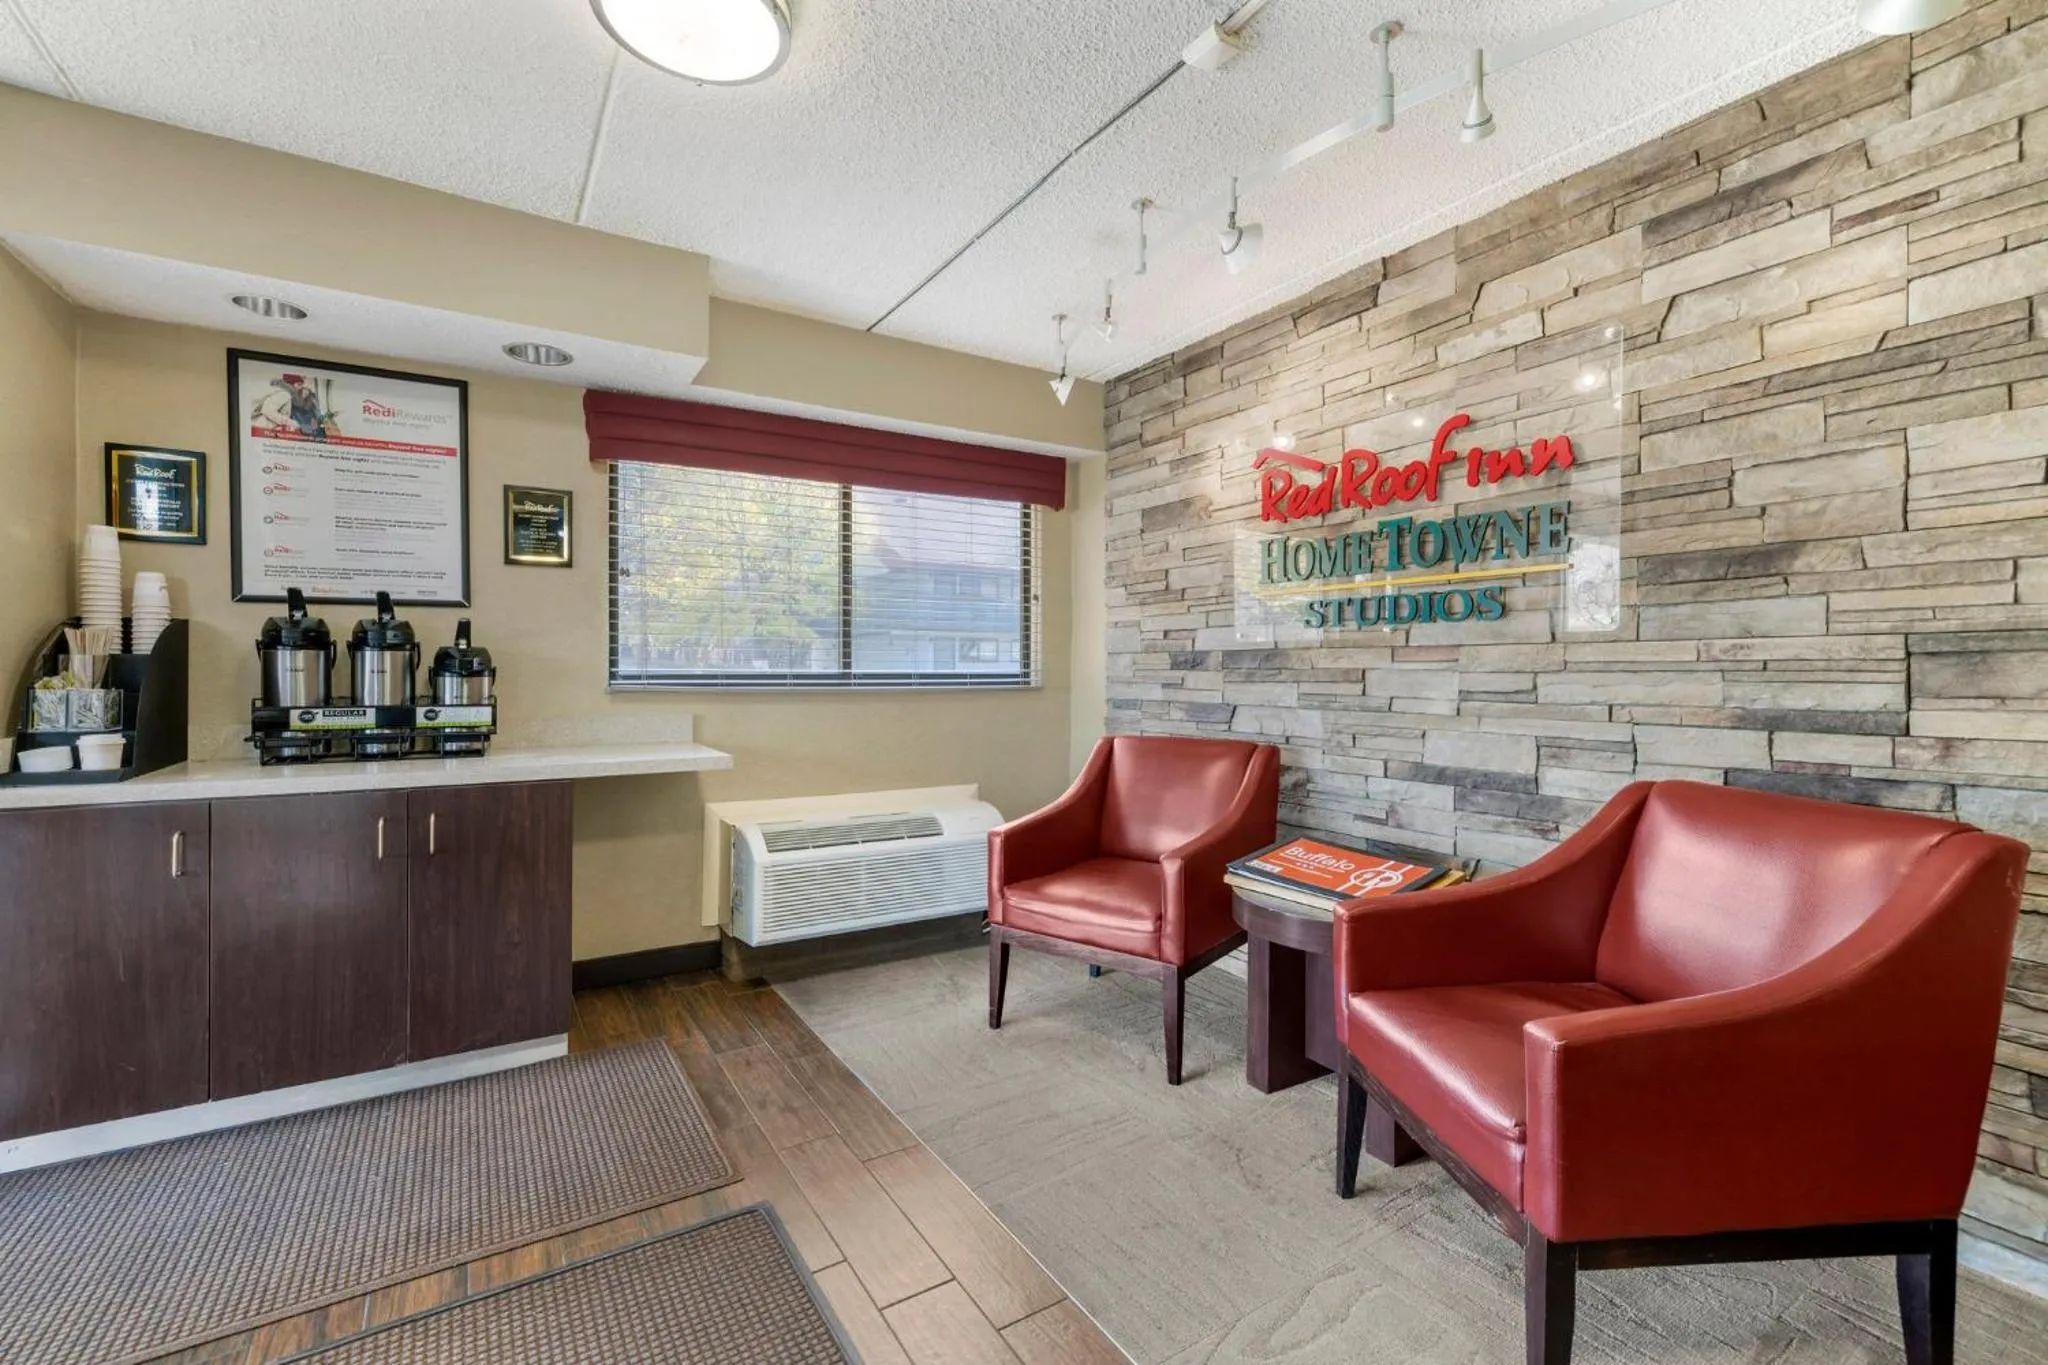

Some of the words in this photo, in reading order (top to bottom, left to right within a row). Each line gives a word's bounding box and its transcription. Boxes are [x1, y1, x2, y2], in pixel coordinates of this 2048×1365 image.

[1260, 459, 1338, 523] Red
[1340, 414, 1471, 509] Roof
[1258, 500, 1573, 586] HOMETOWNE
[1303, 585, 1507, 629] STUDIOS
[1284, 846, 1356, 872] Buffalo
